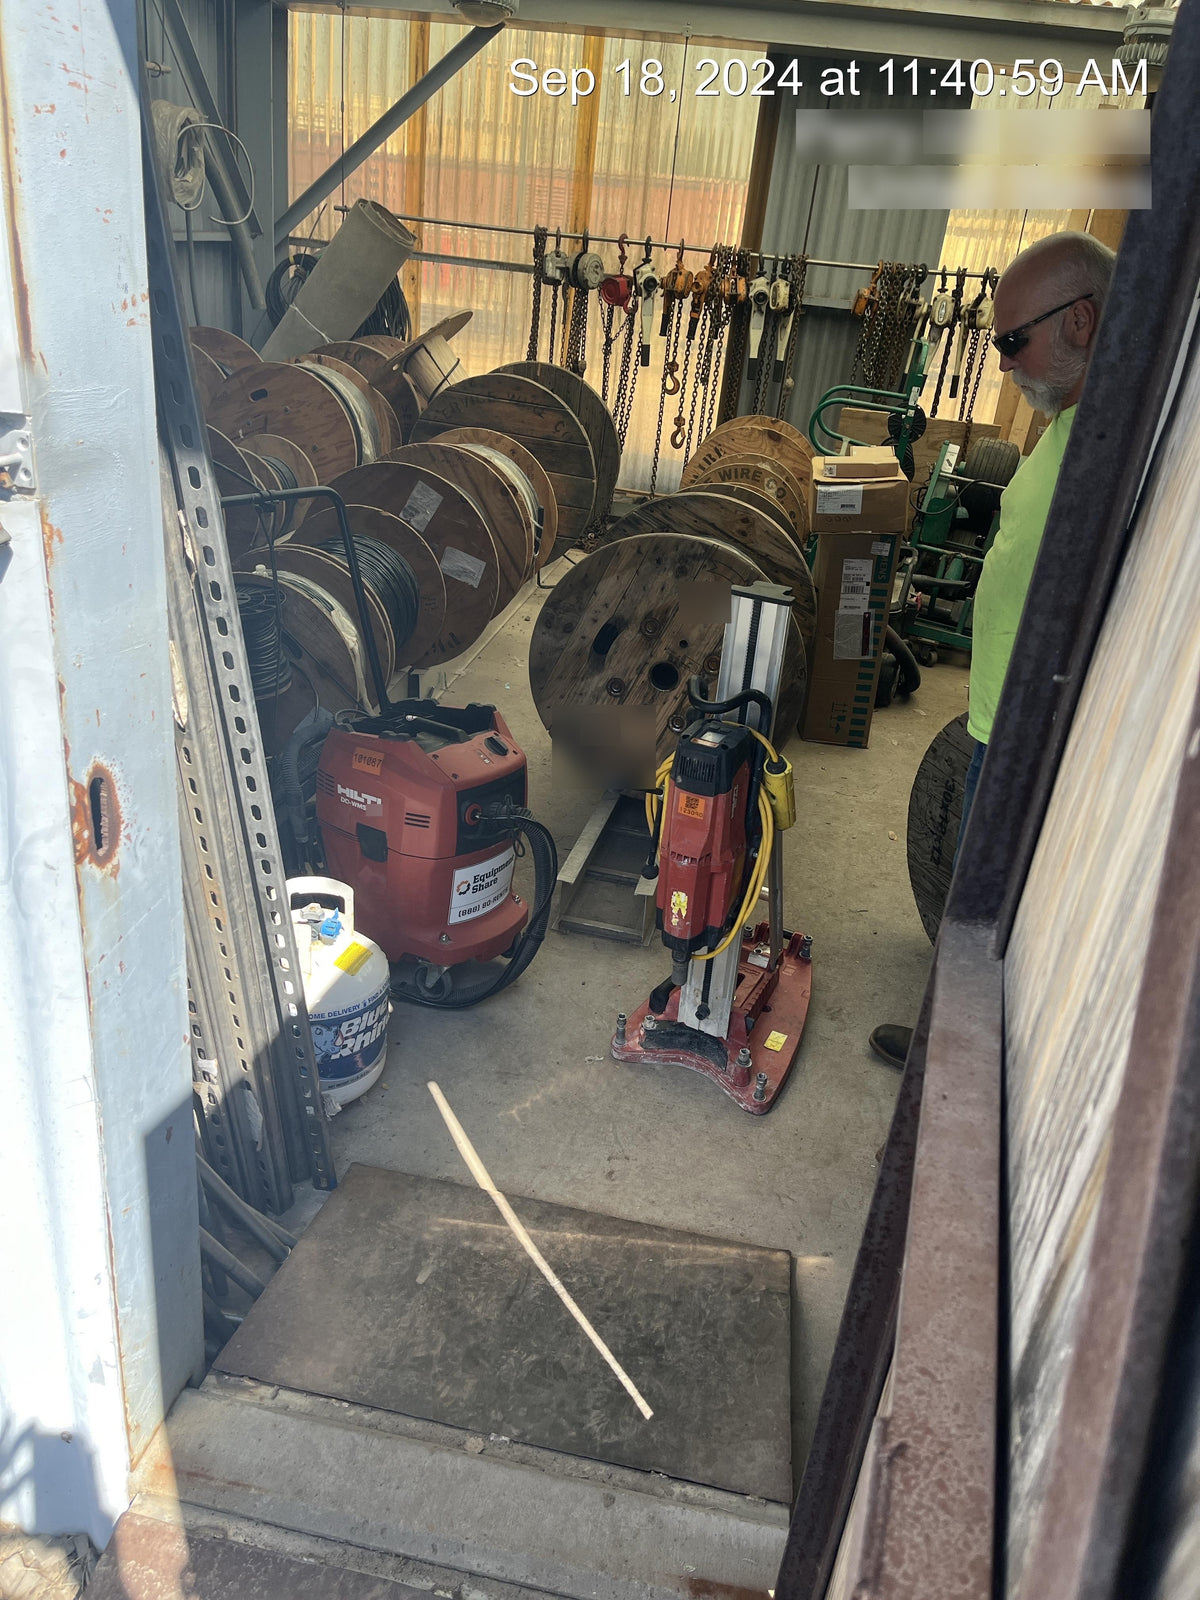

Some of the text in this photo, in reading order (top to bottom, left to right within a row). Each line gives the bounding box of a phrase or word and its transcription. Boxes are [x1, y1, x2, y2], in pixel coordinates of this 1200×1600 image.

[718, 467, 763, 482] WIRE
[337, 783, 383, 806] HILTI
[471, 877, 499, 894] Share
[308, 1012, 326, 1020] OME
[327, 1003, 361, 1018] DELIVERY
[339, 995, 389, 1038] Blue
